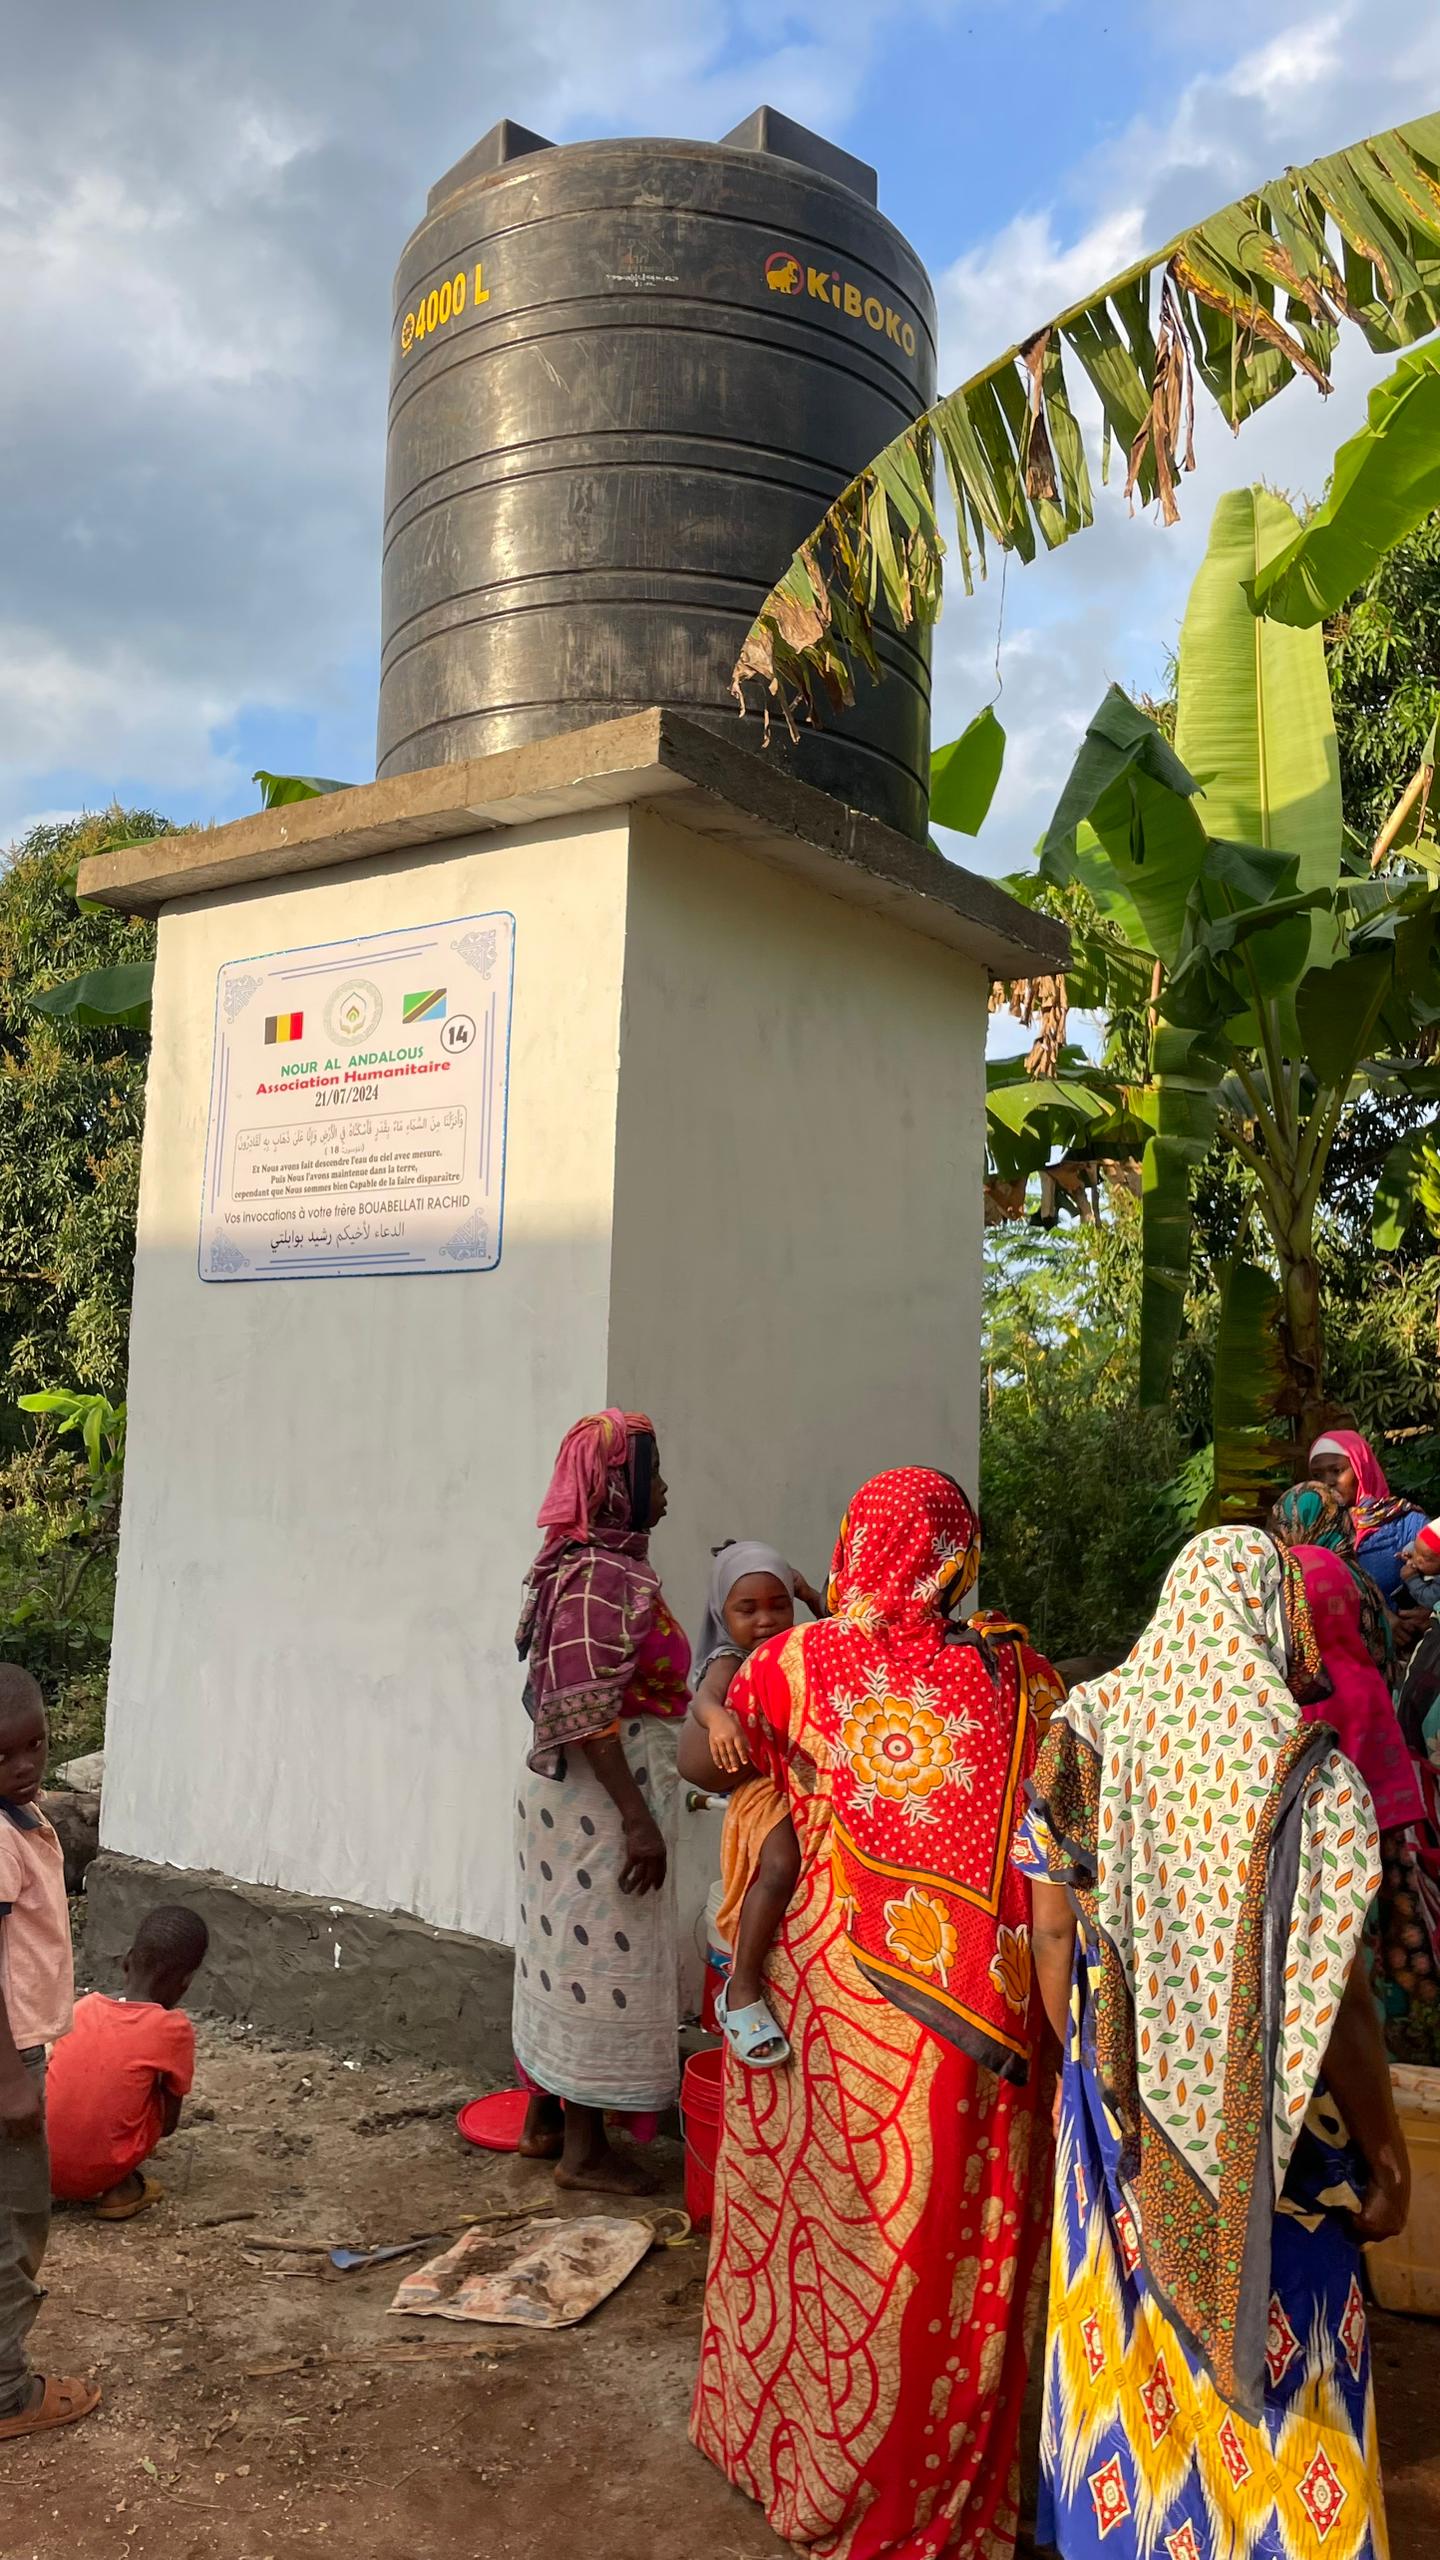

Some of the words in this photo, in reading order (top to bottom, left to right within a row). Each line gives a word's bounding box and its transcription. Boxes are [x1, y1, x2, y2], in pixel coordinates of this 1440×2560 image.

[415, 272, 466, 340] 4000
[474, 264, 490, 306] L
[448, 1026, 468, 1046] 14
[280, 1060, 318, 1078] NOUR
[324, 1055, 342, 1071] AL
[348, 1046, 424, 1068] ANDALOUS
[256, 1076, 339, 1095] Association
[344, 1061, 451, 1084] Humanitaire
[314, 1084, 379, 1108] 21/07/2024
[262, 1164, 279, 1174] Nous
[280, 1163, 300, 1172] avons
[301, 1160, 314, 1170] fait
[314, 1157, 350, 1168] descendre
[368, 1153, 378, 1162] du
[380, 1152, 392, 1162] ciel
[394, 1151, 410, 1160] avec
[412, 1149, 442, 1159] mesure.
[270, 1174, 286, 1184] Puis
[287, 1174, 304, 1183] Nous
[331, 1168, 368, 1179] maintenue
[370, 1166, 386, 1175] dans
[388, 1164, 394, 1174] la
[396, 1164, 418, 1173] terre,
[234, 1188, 270, 1200] cependant
[271, 1188, 284, 1198] que
[285, 1186, 302, 1195] Nous
[304, 1184, 332, 1193] sommes
[333, 1182, 348, 1191] bien
[349, 1178, 377, 1190] Capable
[378, 1178, 388, 1186] de
[388, 1176, 396, 1186] la
[397, 1176, 415, 1186] faire
[416, 1172, 460, 1184] disparaître
[224, 1212, 241, 1224] Vos
[242, 1209, 296, 1222] invocations
[298, 1206, 306, 1219] à
[308, 1206, 332, 1218] votre
[334, 1202, 356, 1216] frère
[358, 1198, 424, 1215] BOUABELLATI
[427, 1194, 470, 1210] RACHID
[308, 1227, 332, 1247] رشيد
[375, 1222, 405, 1238] الدعاء
